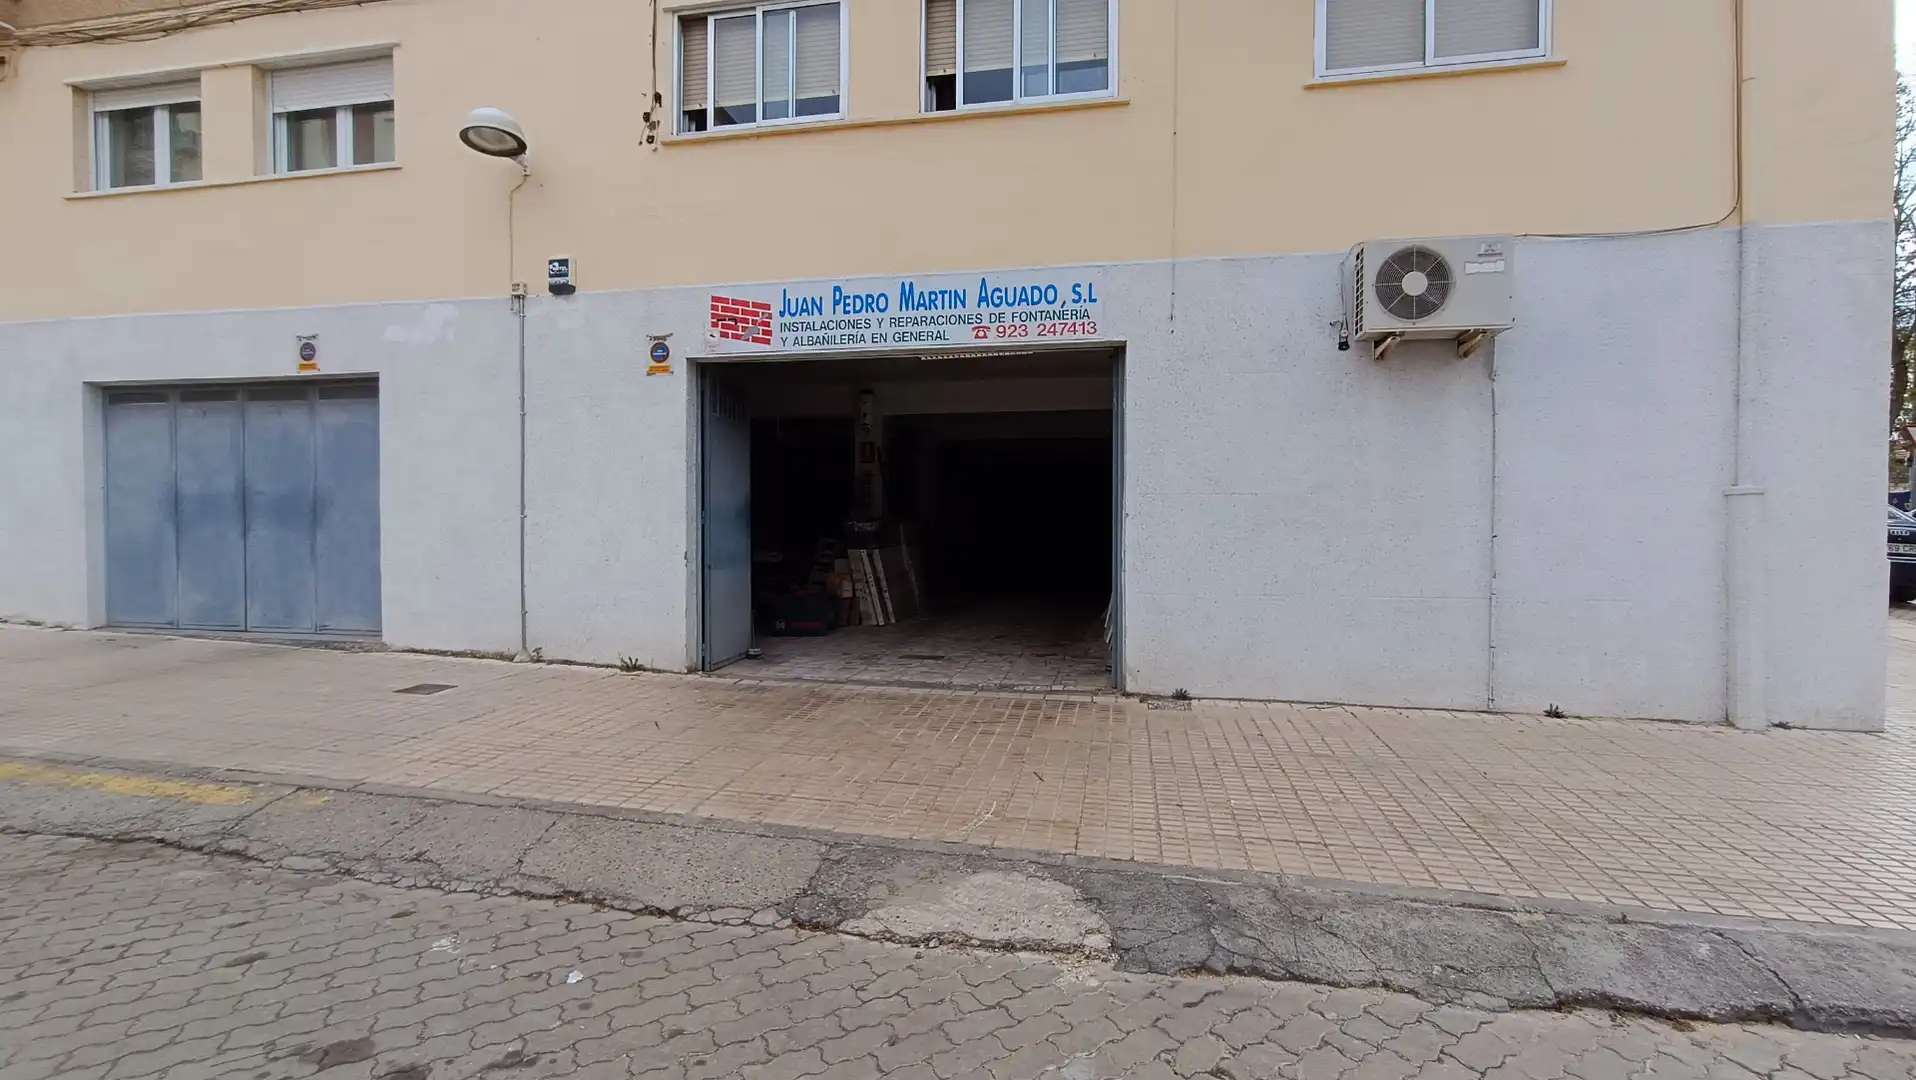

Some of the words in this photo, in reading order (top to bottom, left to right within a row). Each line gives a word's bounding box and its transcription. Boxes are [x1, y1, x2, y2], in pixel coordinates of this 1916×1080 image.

[779, 288, 823, 318] JUAN
[832, 285, 889, 315] PEDRO
[899, 281, 967, 312] MARTIN
[780, 318, 872, 333] INSTALACIONES
[876, 317, 885, 329] Y
[889, 313, 983, 329] REPARACIONES
[989, 312, 1006, 324] DE
[1011, 305, 1091, 323] FONTANERÍA
[780, 336, 789, 347] Y
[793, 330, 867, 347] ALBAÑILERÍA
[871, 331, 888, 344] EN
[892, 329, 950, 342] GENERAL
[995, 324, 1029, 338] 923
[1036, 321, 1098, 337] 247413
